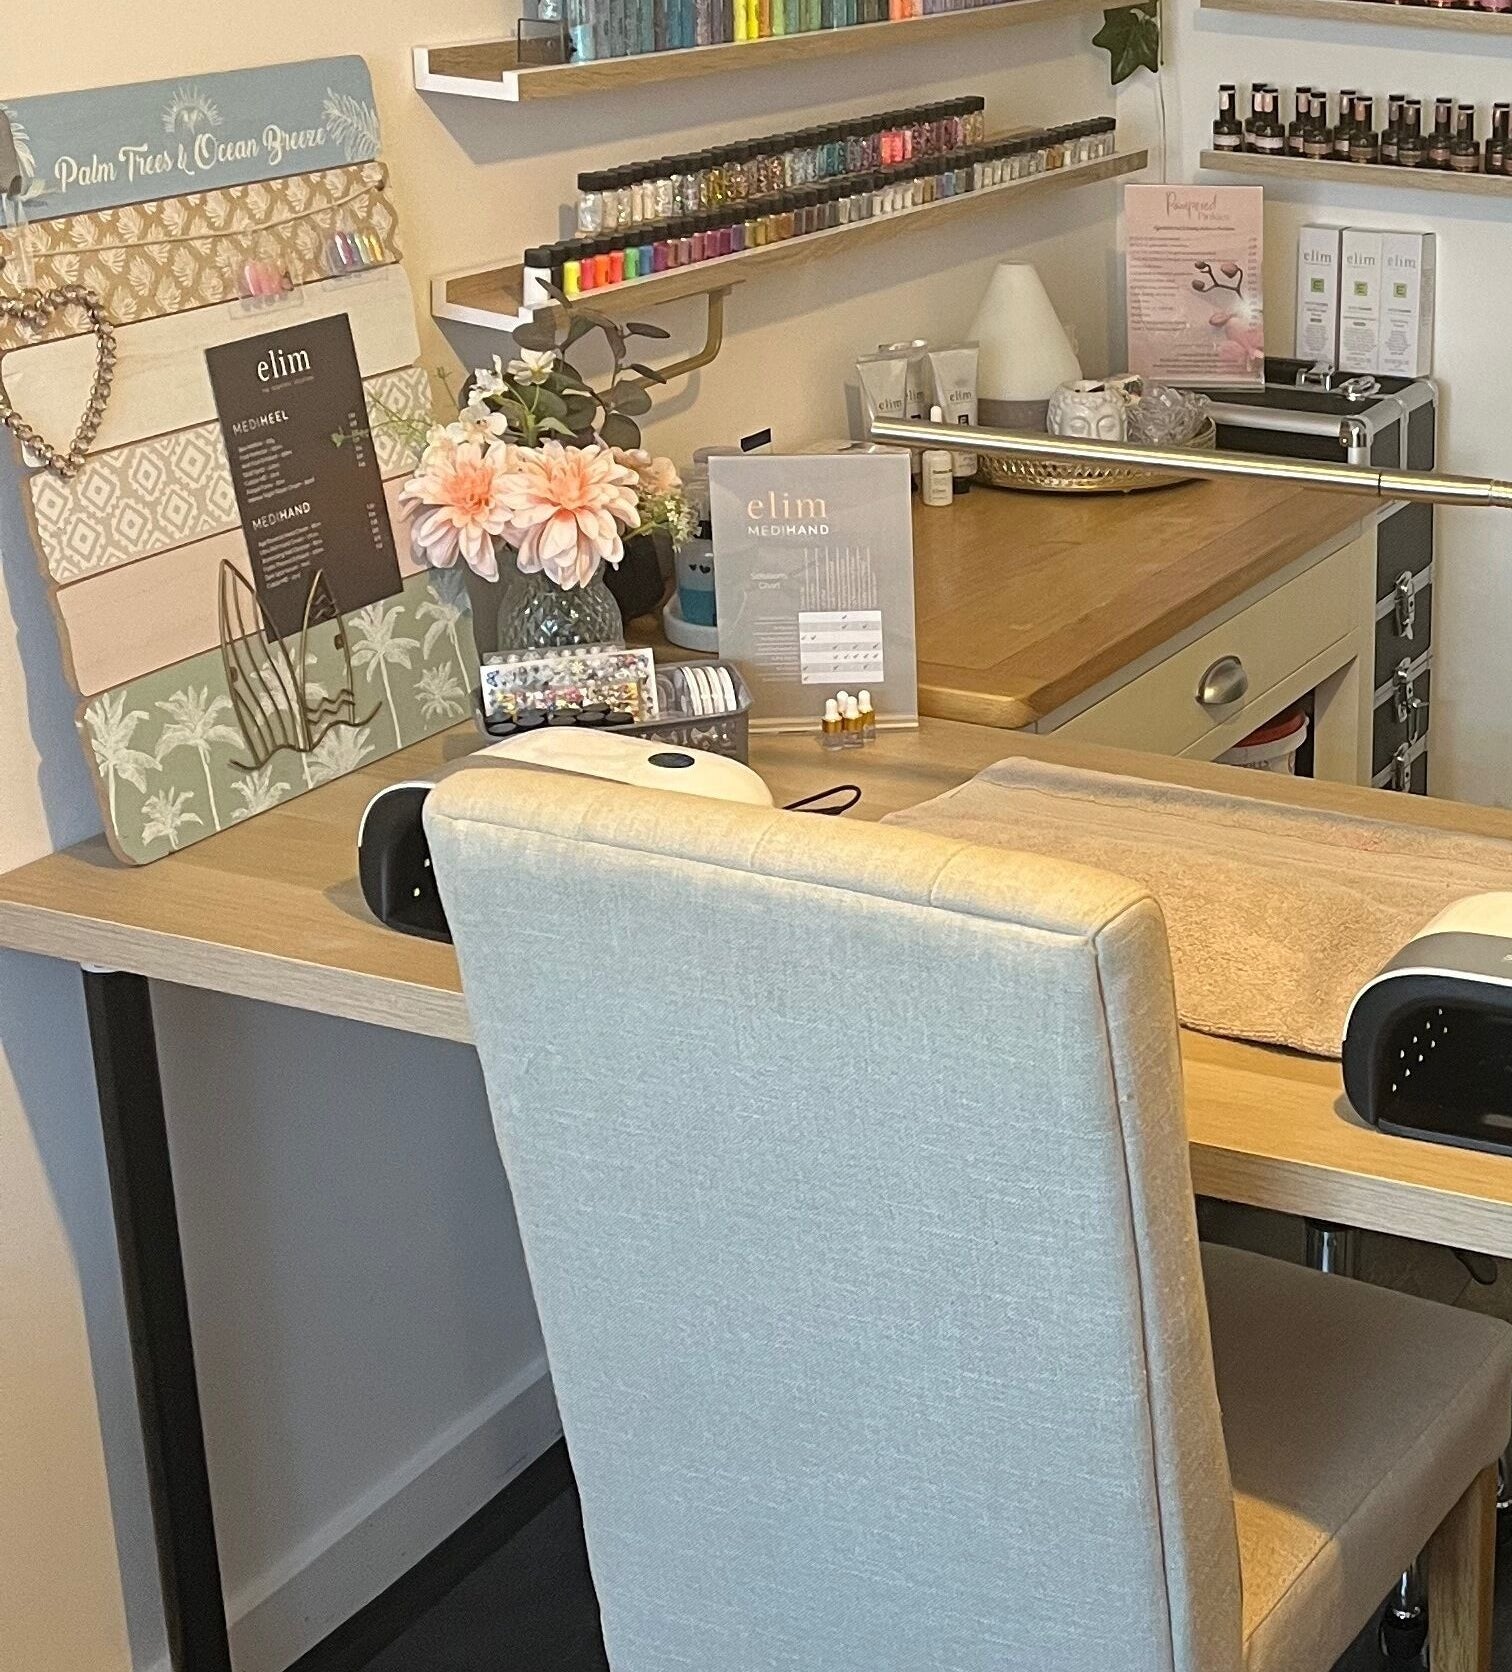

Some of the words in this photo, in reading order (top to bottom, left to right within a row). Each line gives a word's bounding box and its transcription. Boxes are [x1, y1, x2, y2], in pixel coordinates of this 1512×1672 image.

[55, 154, 116, 193] Palm
[118, 143, 173, 183] Trees
[194, 133, 260, 170] Ocean
[262, 124, 326, 166] Breeze
[1303, 250, 1332, 263] elim
[1346, 252, 1376, 266] elim
[1387, 254, 1417, 268] elim
[257, 349, 311, 382] elim
[949, 390, 972, 402] elim
[879, 398, 902, 411] elim
[232, 410, 289, 435] MEDIHEEL
[747, 490, 827, 520] elim
[252, 501, 311, 531] MEDIHAND
[747, 524, 830, 536] MEDIHAND
